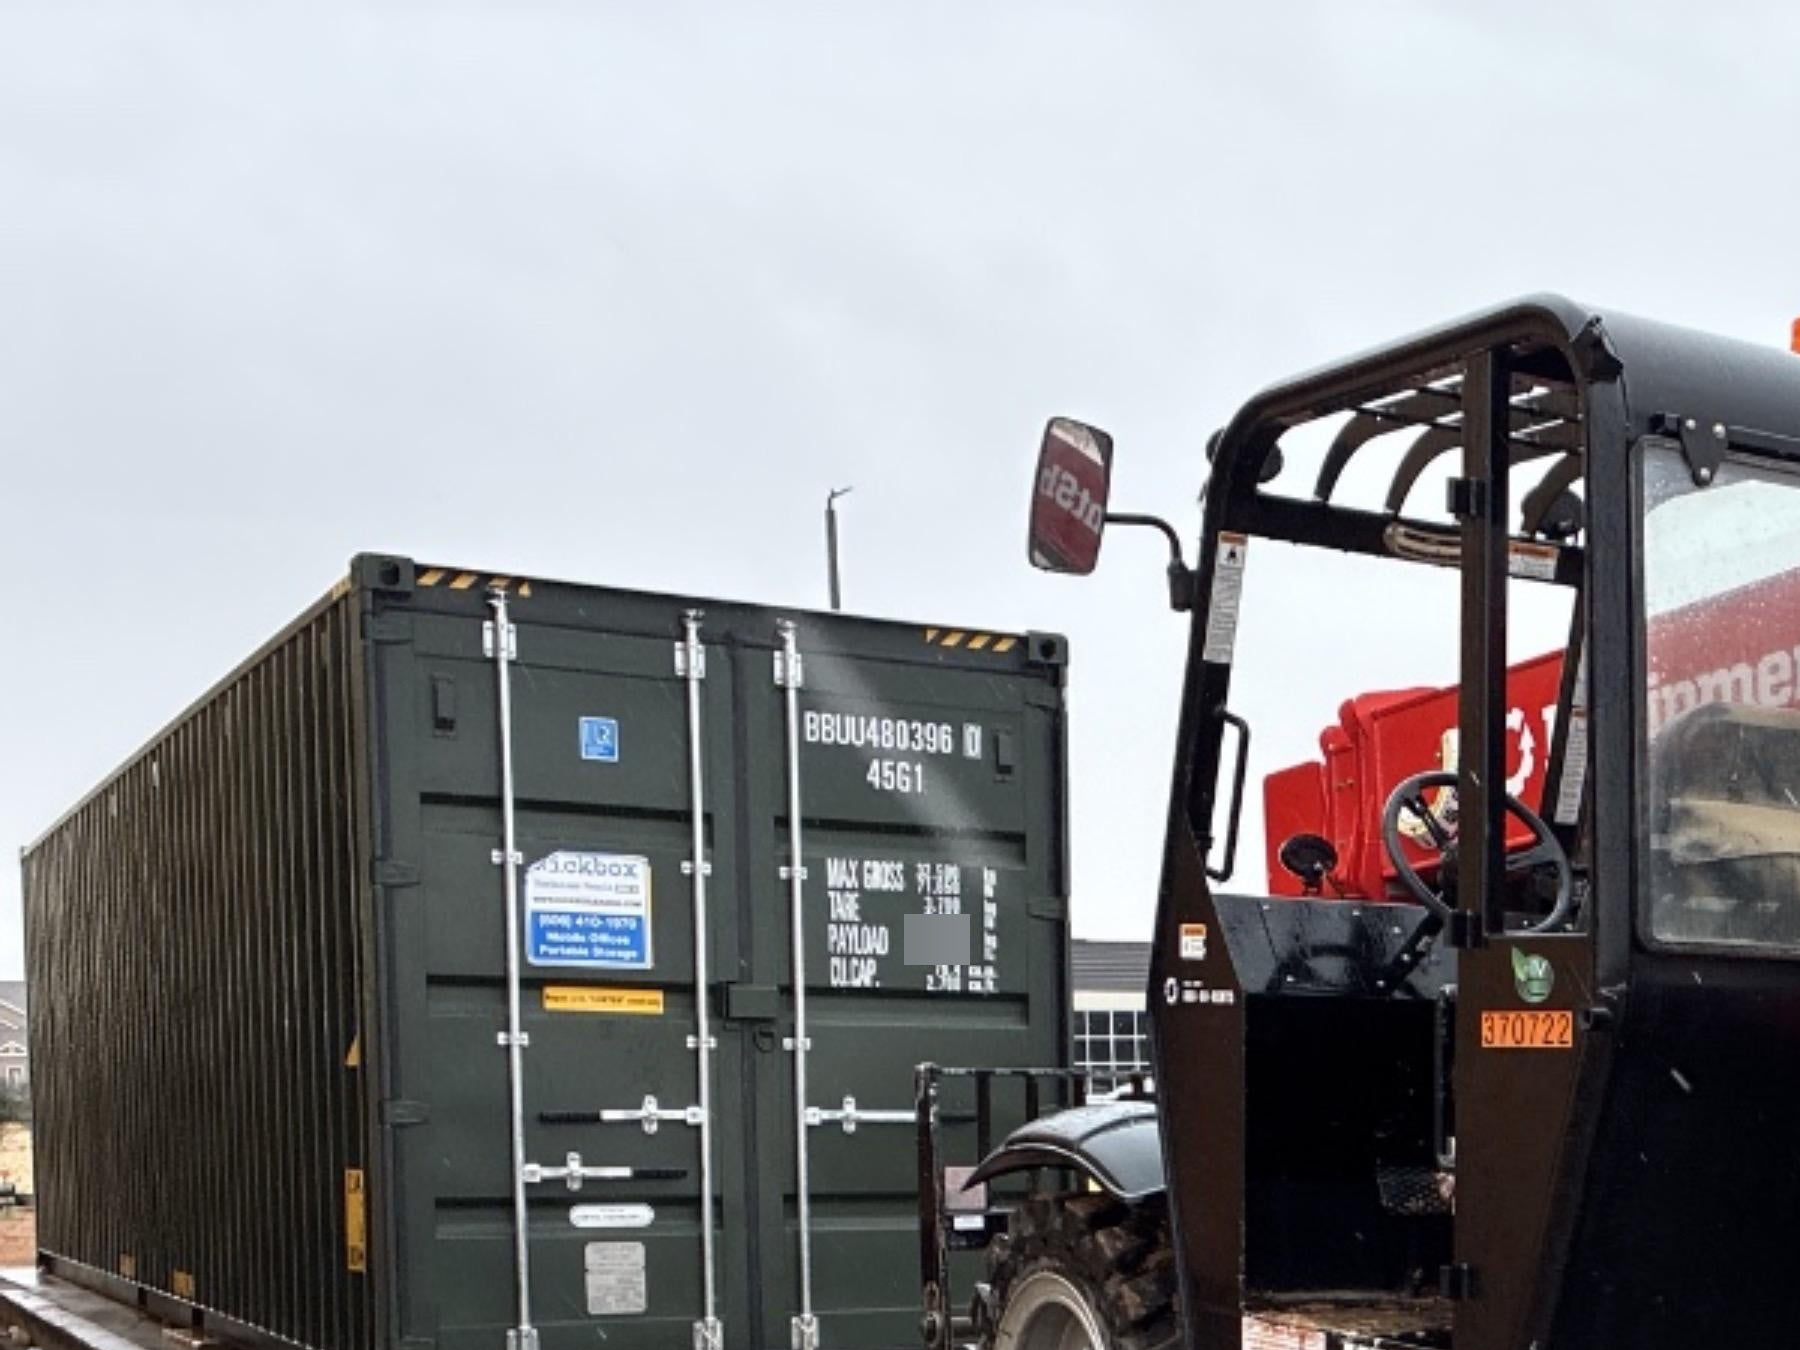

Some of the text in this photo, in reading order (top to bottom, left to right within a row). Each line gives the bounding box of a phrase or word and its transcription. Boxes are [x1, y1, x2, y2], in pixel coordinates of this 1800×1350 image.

[804, 711, 953, 754] BBUU480396
[866, 757, 923, 793] 45G1
[827, 857, 860, 889] MAX
[863, 860, 904, 892] GROSS
[828, 891, 861, 922] TARE
[827, 923, 890, 955] PAYLOAD
[1483, 1013, 1570, 1045] 370722
